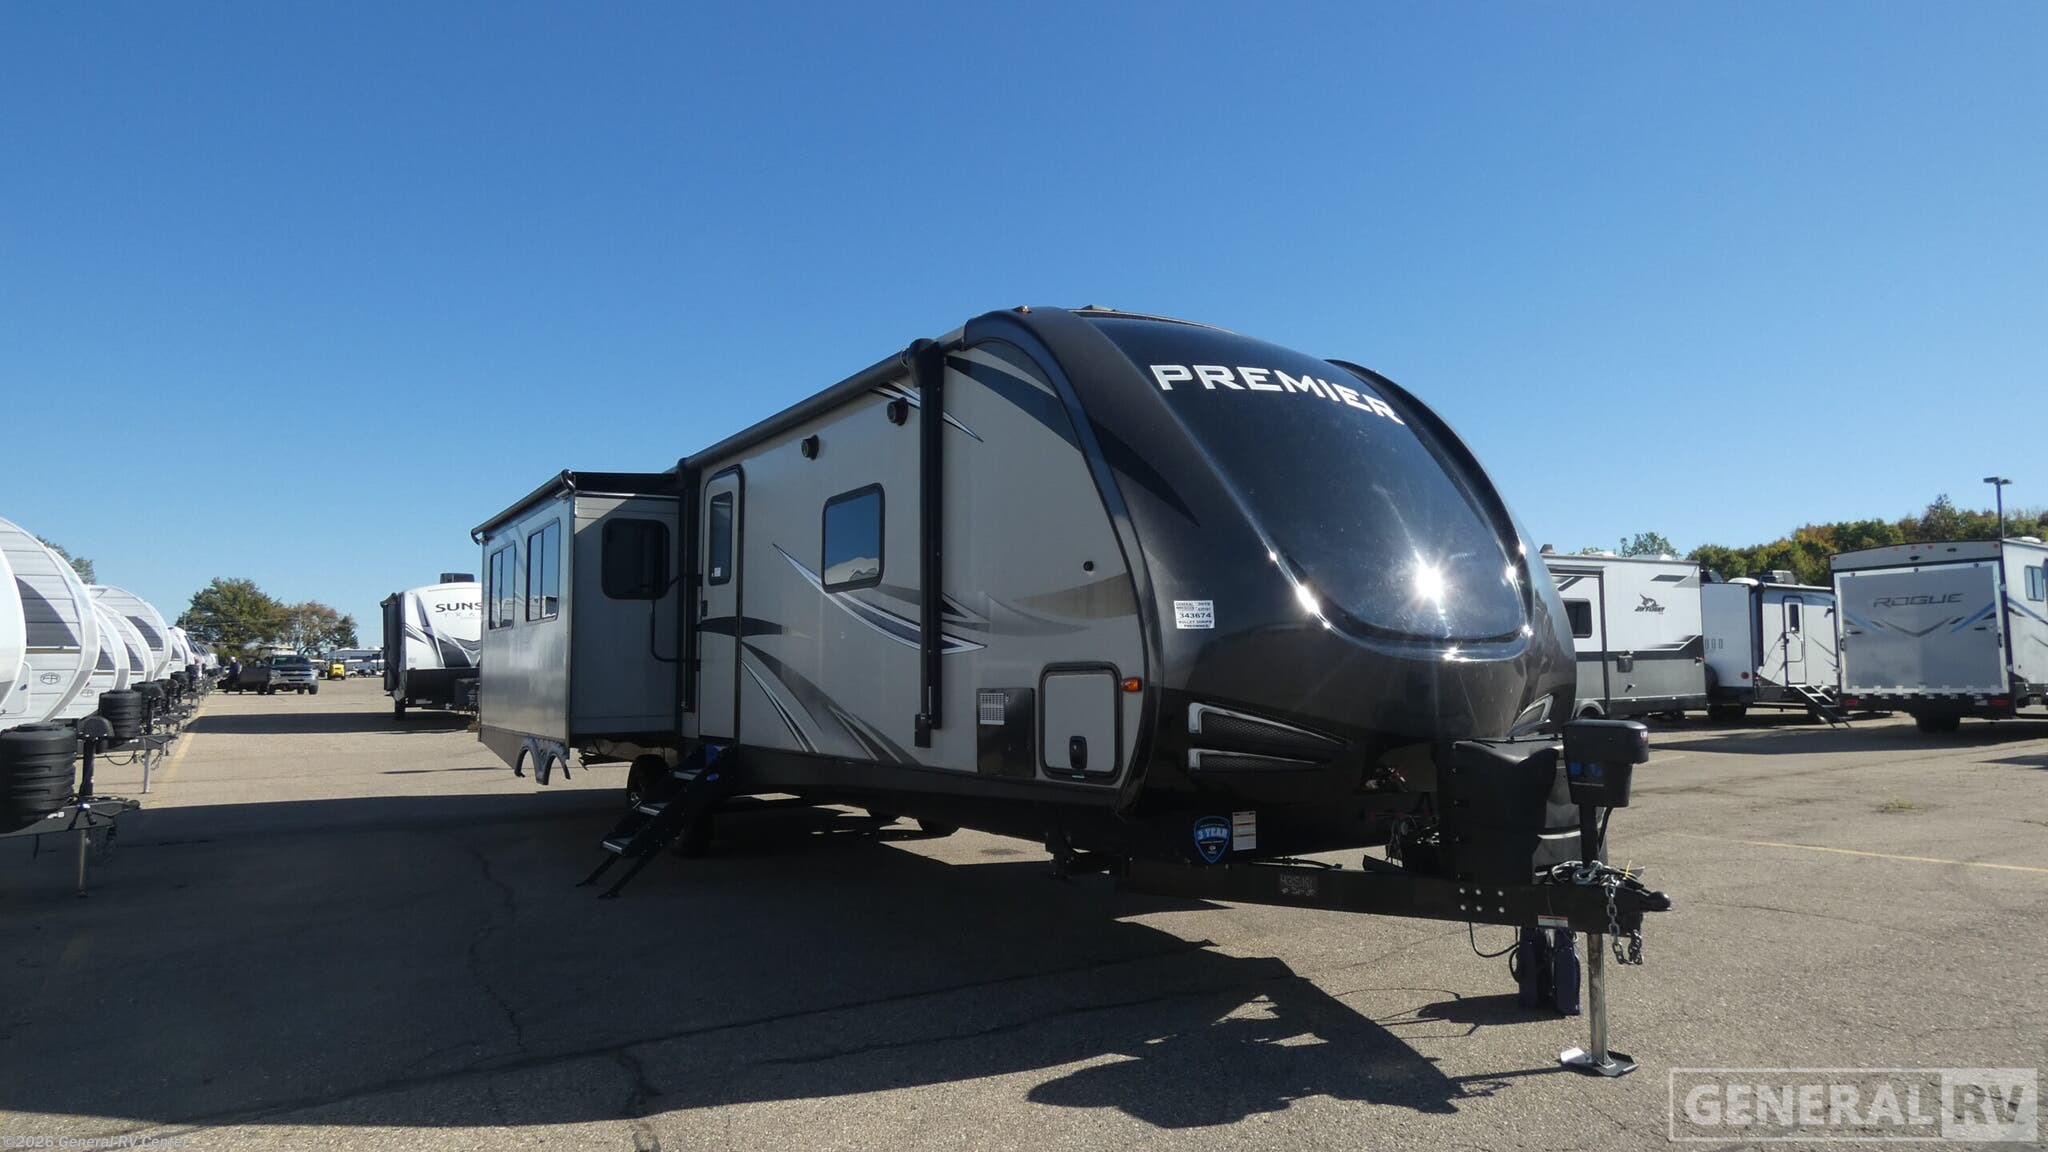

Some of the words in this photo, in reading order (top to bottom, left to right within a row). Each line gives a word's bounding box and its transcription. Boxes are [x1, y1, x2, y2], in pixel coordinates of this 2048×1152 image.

[1149, 364, 1405, 425] PREMIER
[1873, 593, 1965, 608] ROGUE
[1197, 830, 1204, 840] 3
[1205, 827, 1228, 839] YEAR
